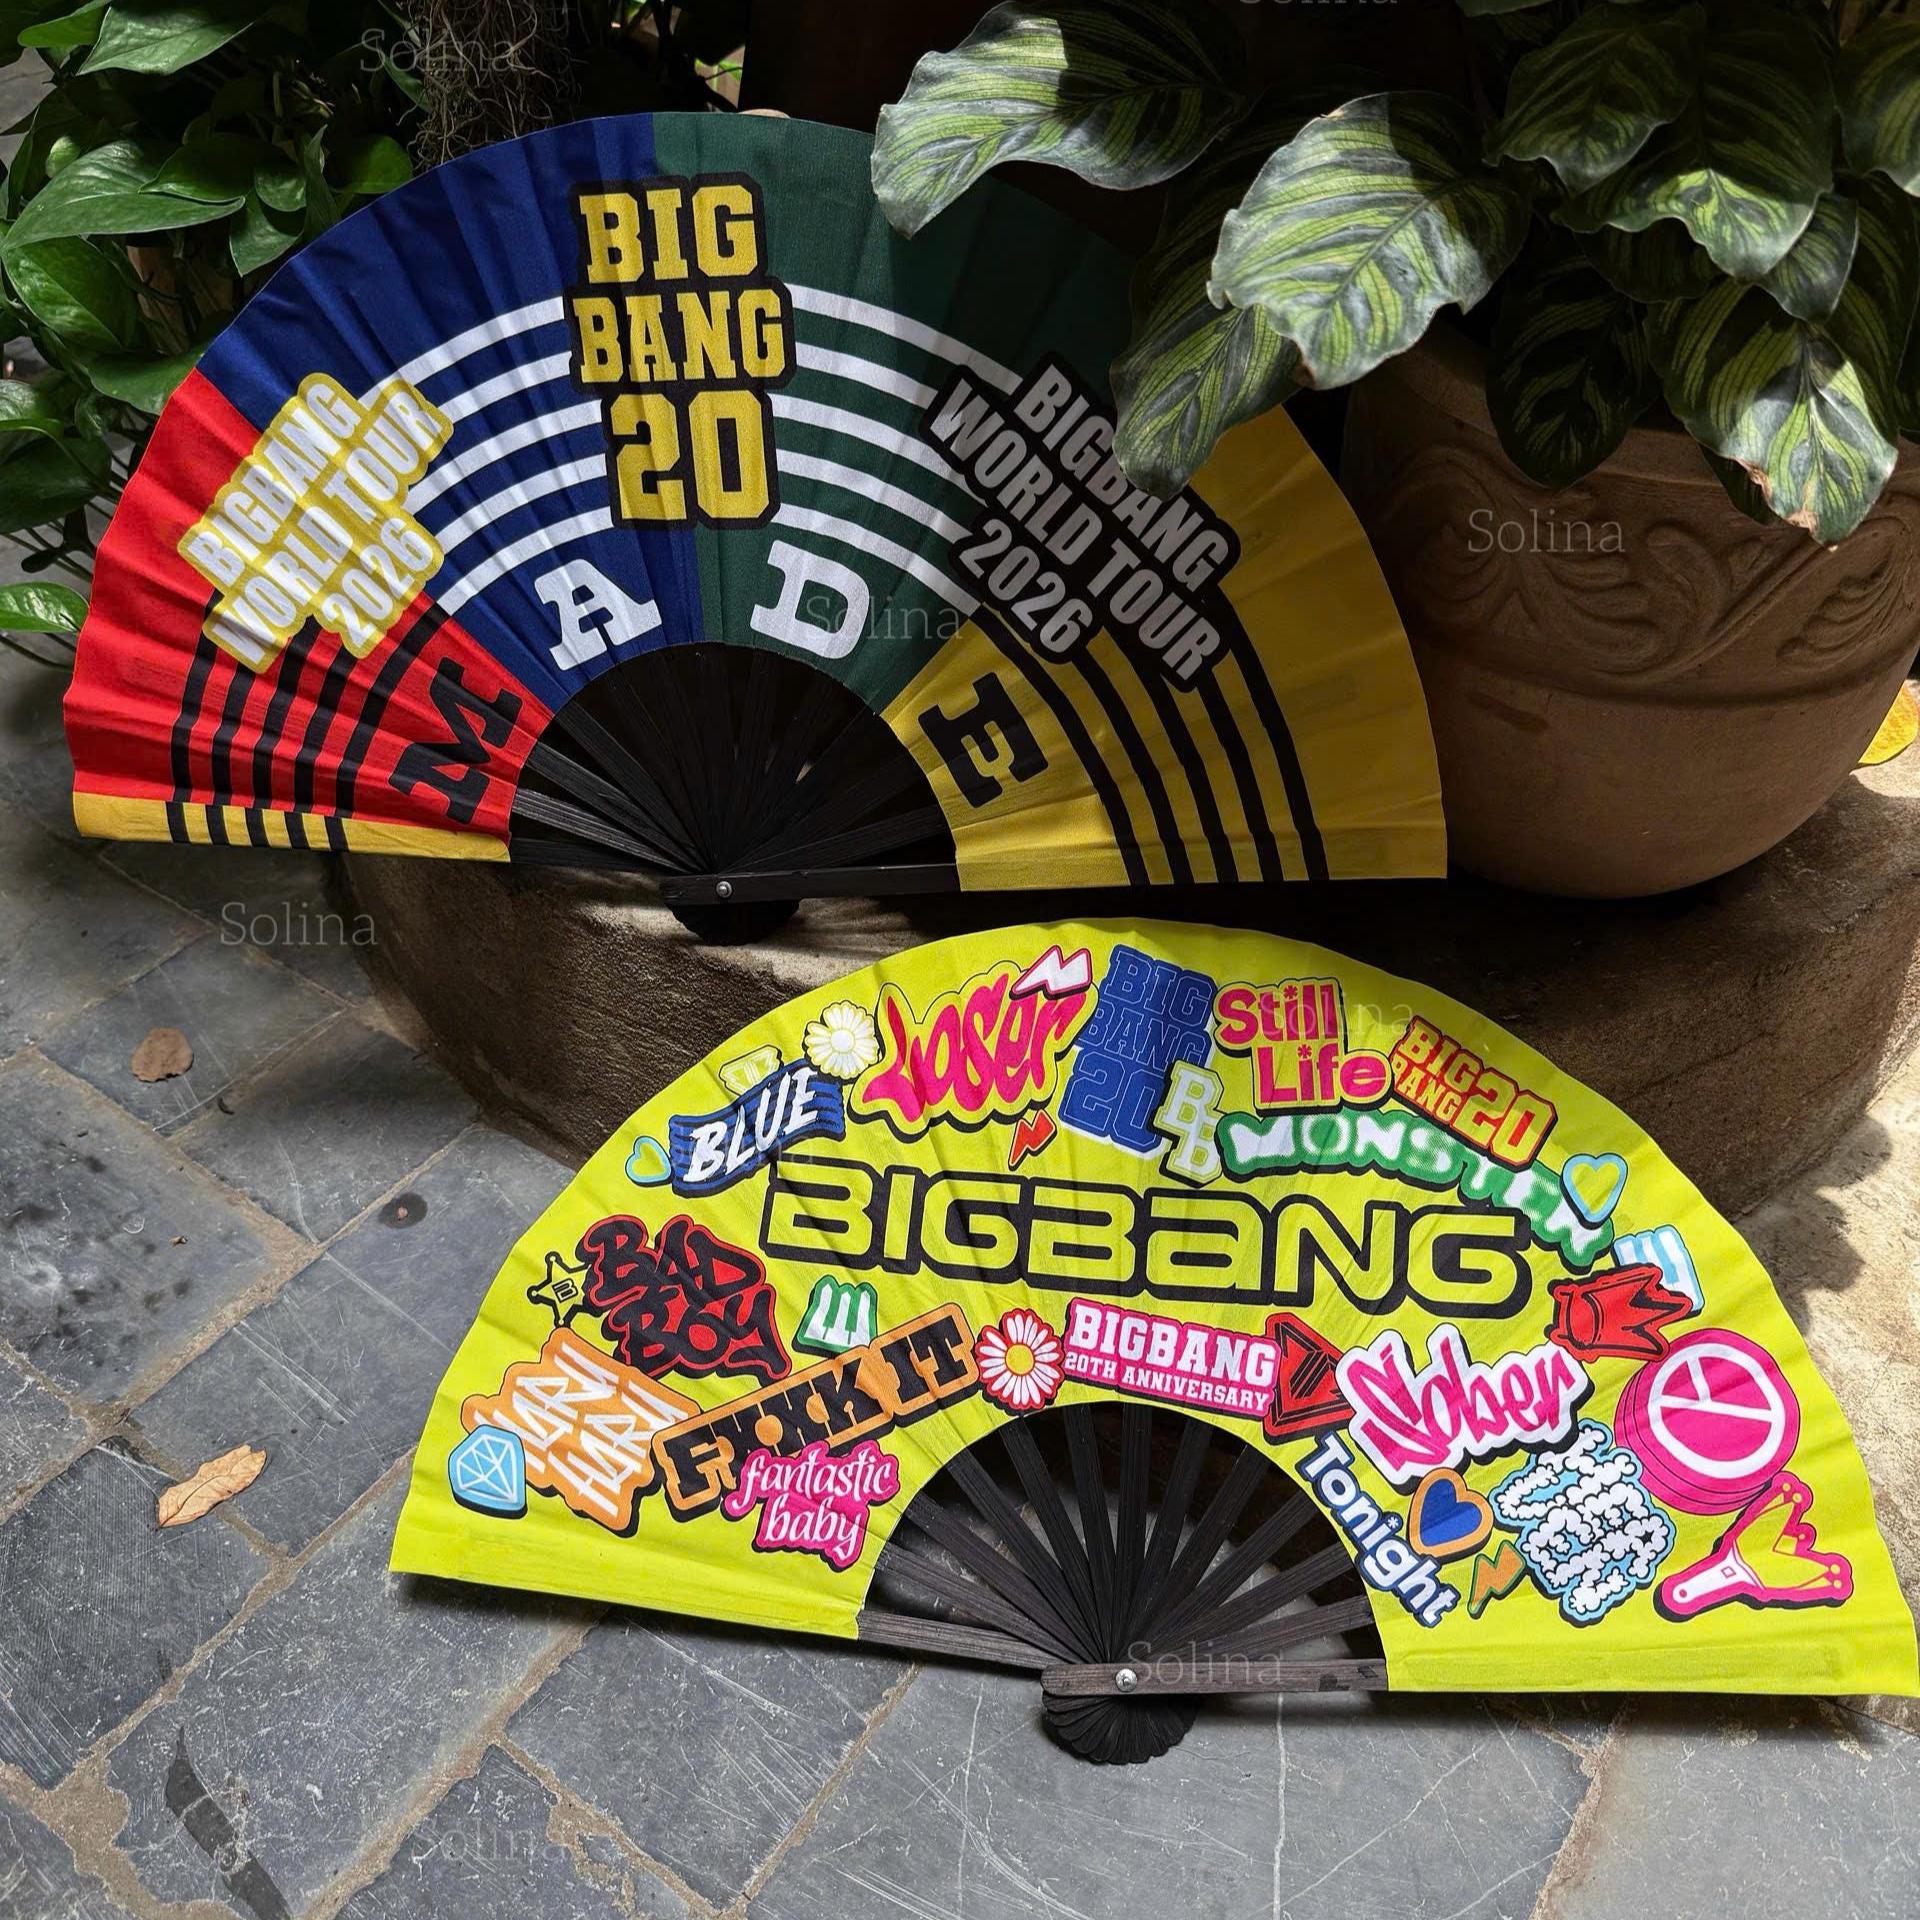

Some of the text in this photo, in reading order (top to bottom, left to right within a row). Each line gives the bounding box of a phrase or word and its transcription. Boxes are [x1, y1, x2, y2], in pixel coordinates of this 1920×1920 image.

[580, 184, 758, 284] BIG
[572, 288, 786, 384] BANG
[186, 383, 362, 588] BIGBANG
[610, 389, 770, 521] 20
[211, 390, 444, 665] WORLD TOUR
[929, 377, 1221, 681] WORLD TOUR
[321, 517, 434, 649] 2026
[958, 518, 1093, 653] 2026
[1103, 950, 1214, 1027] BIG
[1217, 984, 1339, 1045] Still
[861, 972, 1087, 1124] Loser
[1256, 1042, 1388, 1104] Life
[1398, 1019, 1483, 1095] BIG
[682, 1066, 818, 1182] BLUE
[1452, 1070, 1553, 1165] 20
[584, 1215, 766, 1306] BAD
[608, 1284, 793, 1379] BOY
[879, 1314, 969, 1406] IT
[1068, 1303, 1277, 1388] BIGBANG
[1064, 1351, 1270, 1412] 20TH ANNIVERSARY
[1346, 1335, 1576, 1472] Sober
[731, 1444, 892, 1510] fantastic
[764, 1495, 862, 1561] baby
[1304, 1434, 1456, 1627] Tonight
